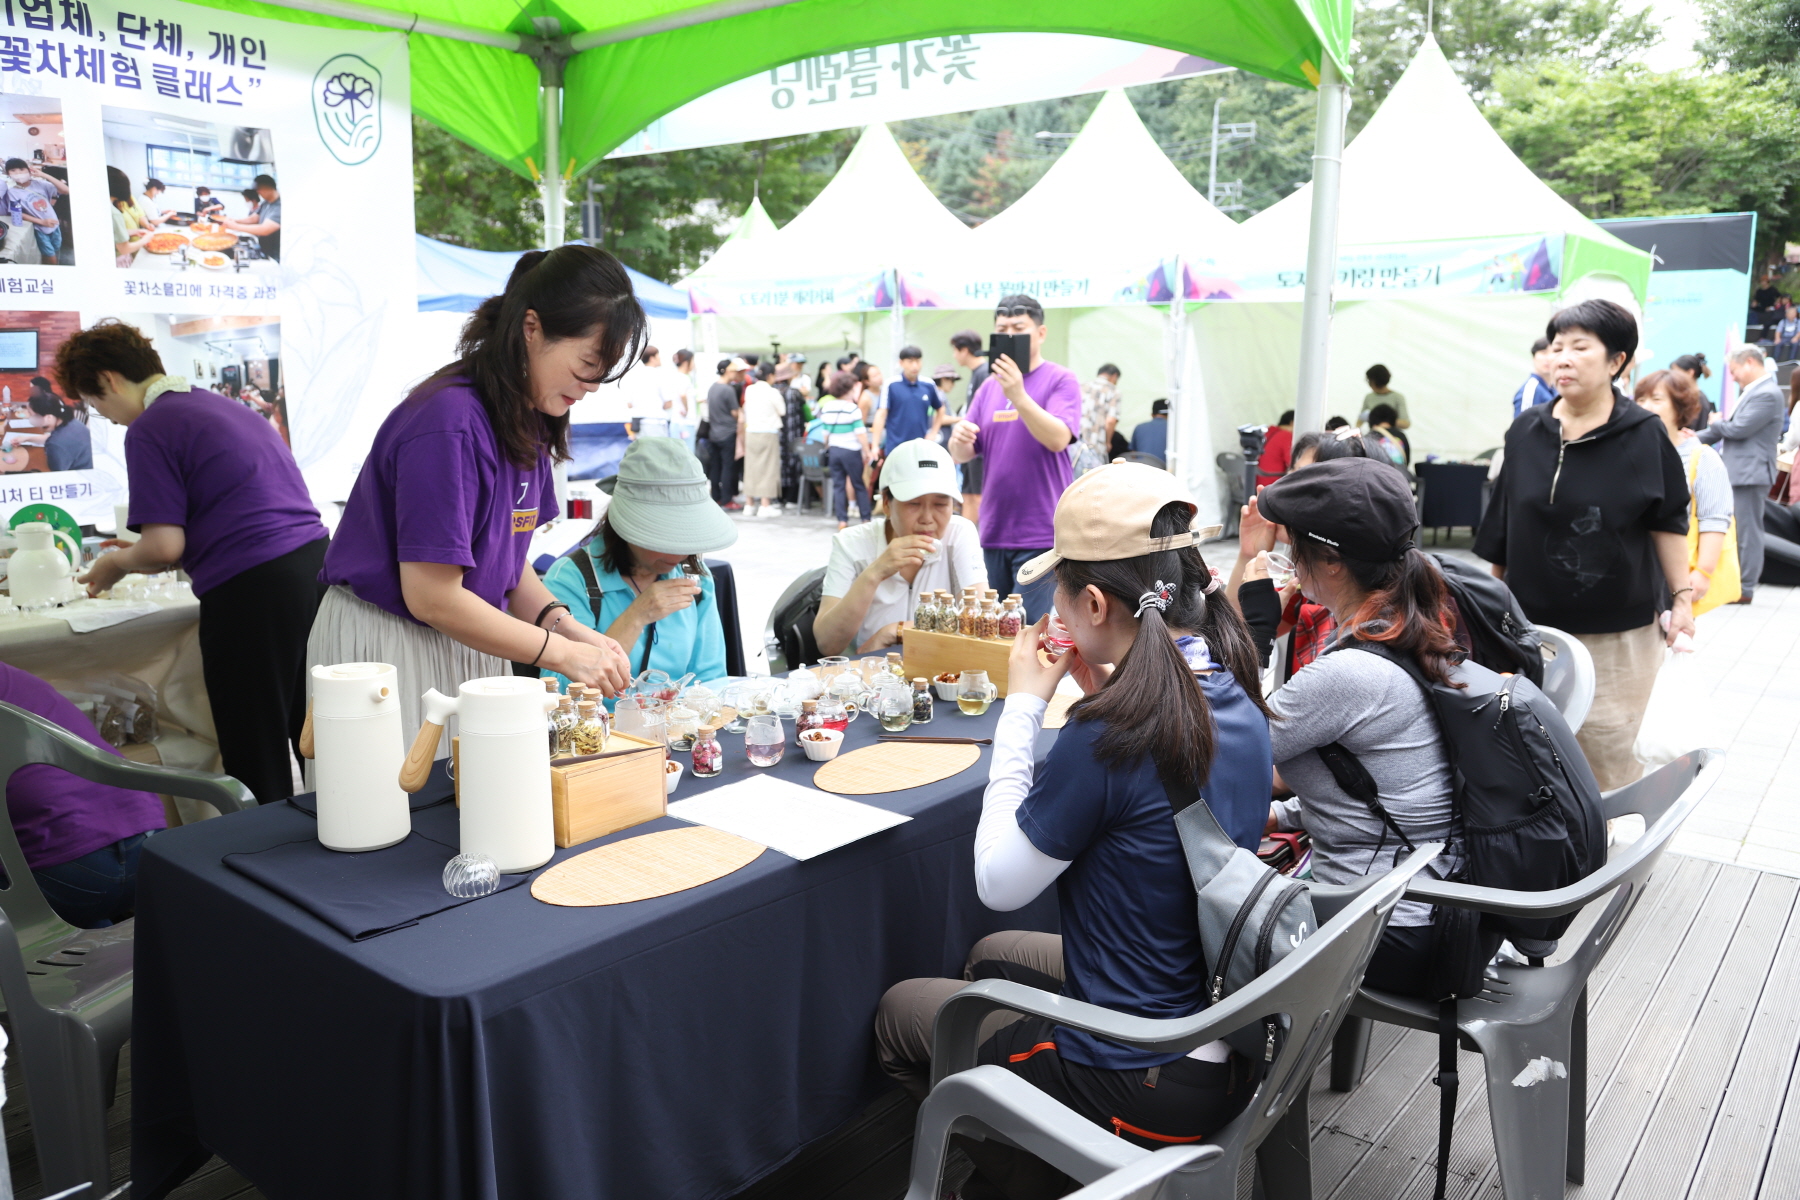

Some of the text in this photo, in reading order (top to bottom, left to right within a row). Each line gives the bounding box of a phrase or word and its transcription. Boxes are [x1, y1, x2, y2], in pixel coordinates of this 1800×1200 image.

[117, 11, 194, 61] 단체,
[208, 31, 266, 70] 개인
[0, 35, 142, 90] 꽃차체험
[1380, 264, 1441, 289] 만들기
[208, 284, 248, 299] 자격증
[253, 286, 277, 299] 과정
[964, 281, 993, 300] 나무
[1043, 277, 1090, 297] 만들기
[29, 486, 43, 500] 티
[49, 482, 92, 500] 만들기
[516, 482, 529, 505] 7
